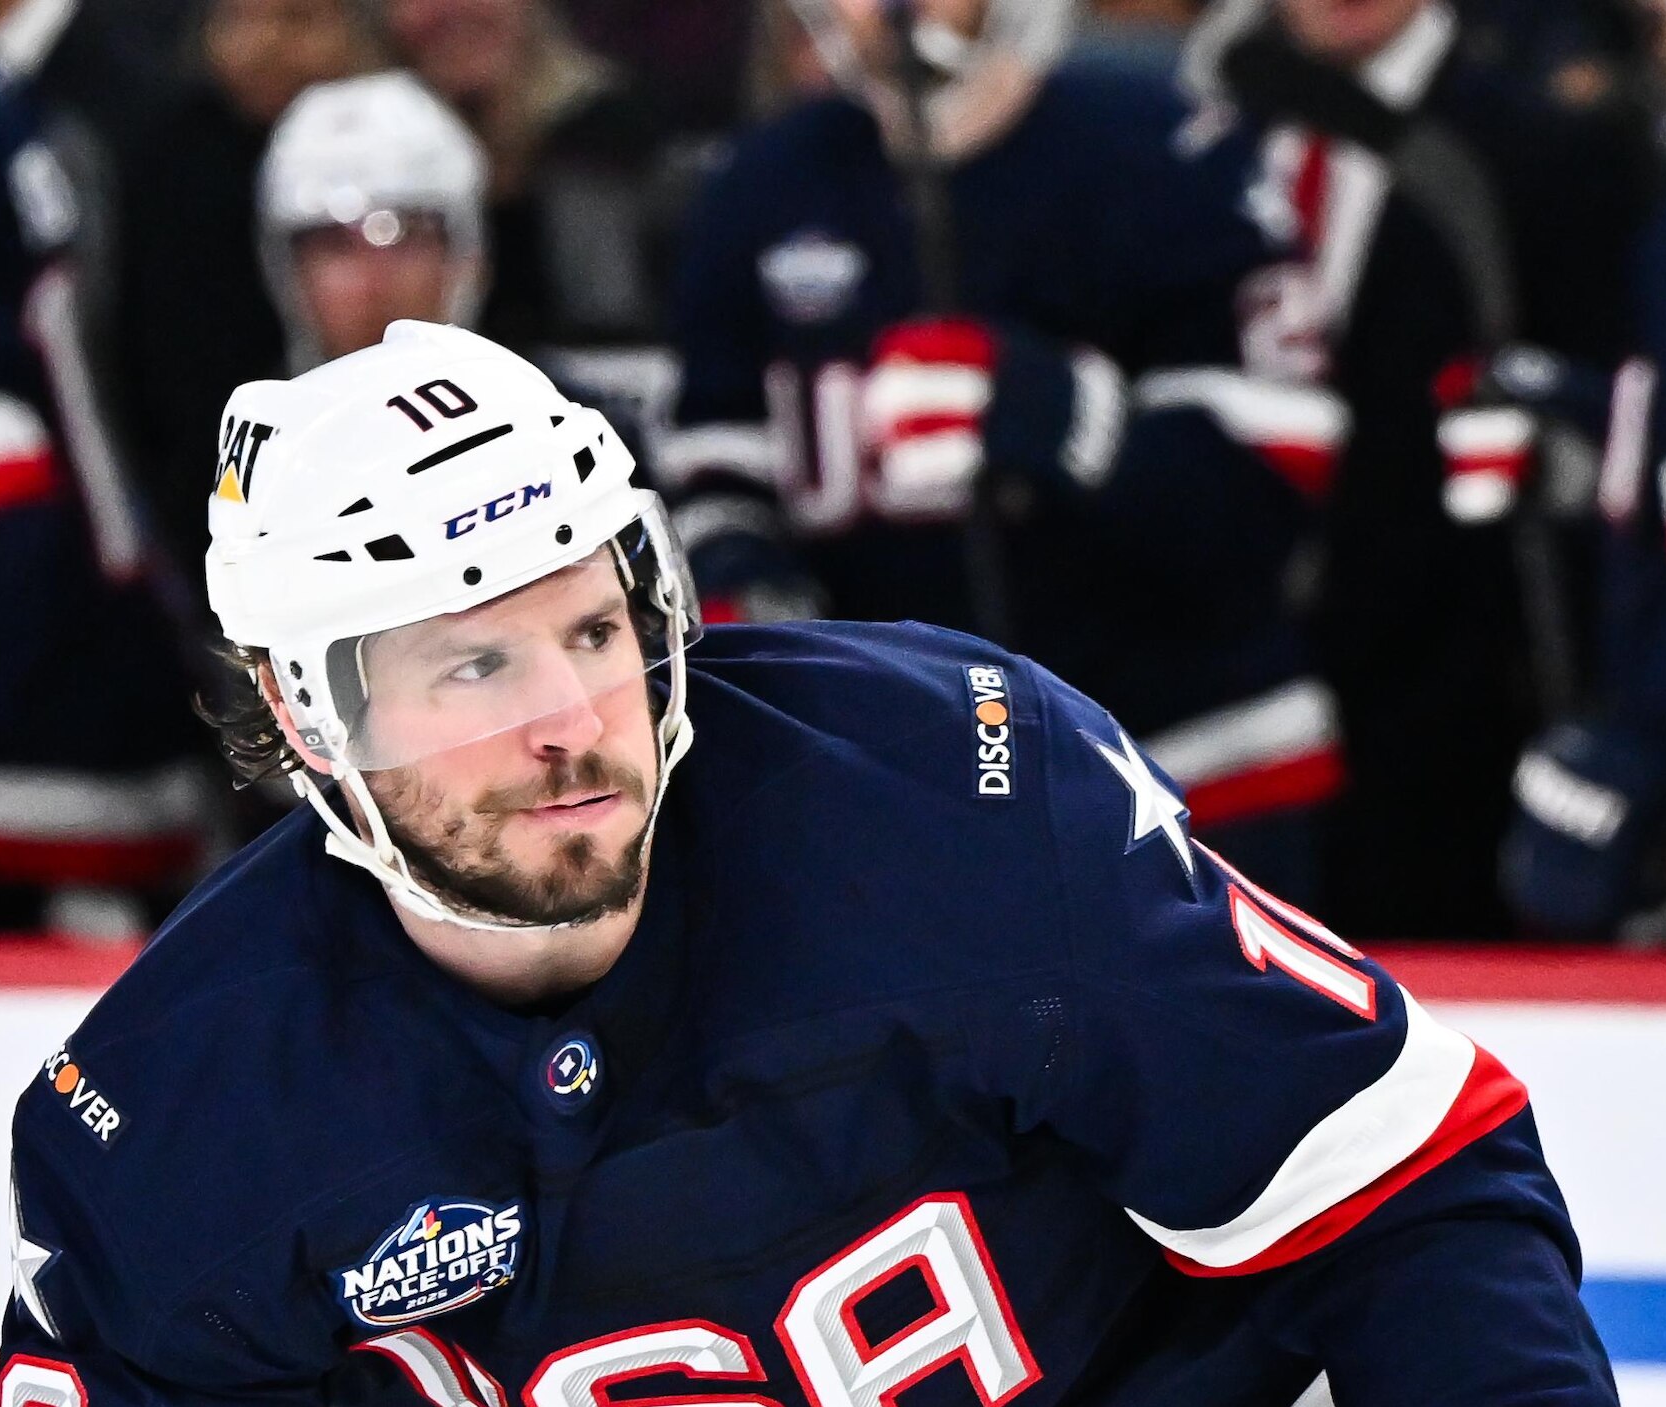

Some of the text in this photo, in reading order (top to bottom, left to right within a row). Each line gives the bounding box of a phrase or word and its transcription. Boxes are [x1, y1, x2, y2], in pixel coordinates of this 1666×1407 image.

[386, 379, 478, 432] 10
[441, 479, 551, 540] CCM
[968, 667, 1010, 795] DISCOVER
[342, 1205, 521, 1298] NATIONS
[361, 1242, 507, 1312] FACE-OFF
